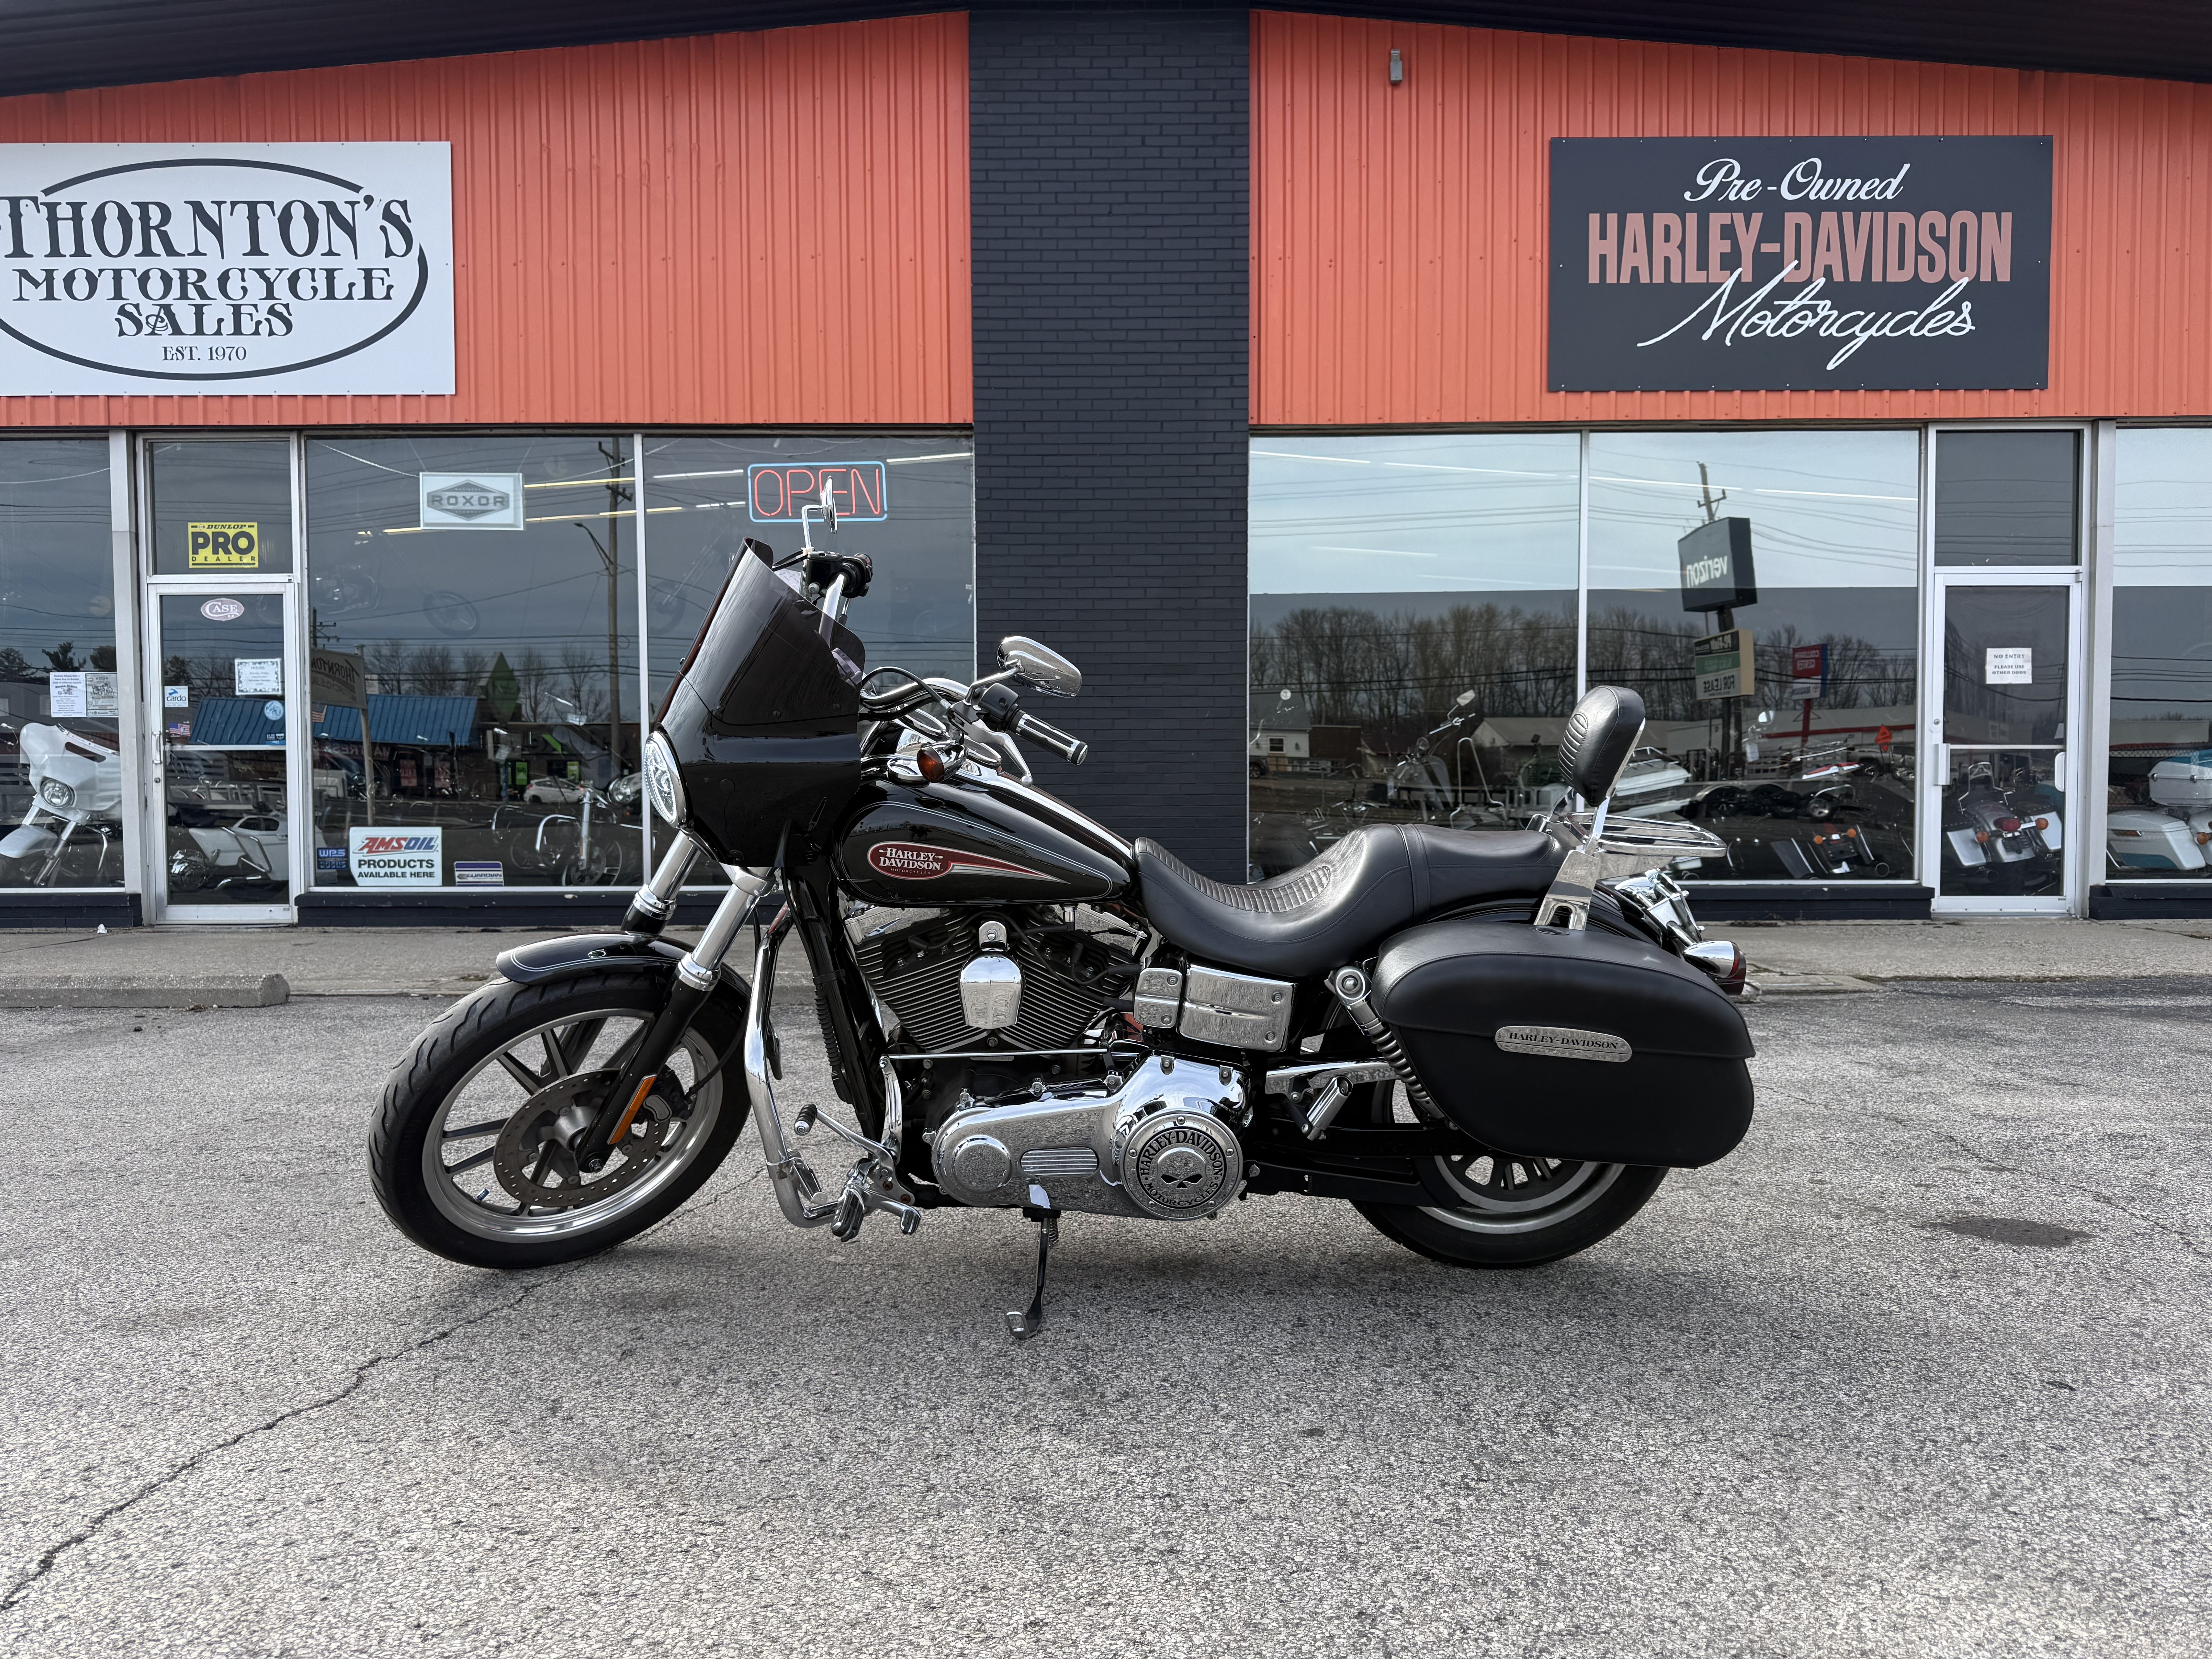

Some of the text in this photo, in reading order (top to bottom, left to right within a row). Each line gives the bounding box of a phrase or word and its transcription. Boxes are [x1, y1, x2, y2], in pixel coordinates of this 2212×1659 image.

[1684, 158, 1910, 201] Pre-Owned
[0, 195, 413, 259] THORNTON'S
[1588, 211, 2012, 283] HARLEY-DAVIDSON
[12, 268, 394, 301] MOTORCYCLE
[115, 303, 293, 337] SALES
[1637, 260, 1975, 370] Motorcycles
[162, 346, 247, 361] EST. 1970
[431, 495, 505, 506] ROXOR
[754, 469, 881, 516] OPEN
[191, 531, 255, 555] PRO
[205, 602, 238, 617] CASE
[357, 837, 436, 854] AMSOIL
[358, 859, 434, 869] PRODUCTS
[879, 857, 941, 870] DAVIDSON
[1509, 1033, 1618, 1049] HARLEY-DAVIDSON
[1140, 1130, 1223, 1176] HARLEY-DAVIDSON
[1144, 1182, 1219, 1206] MOTORCYCLES
